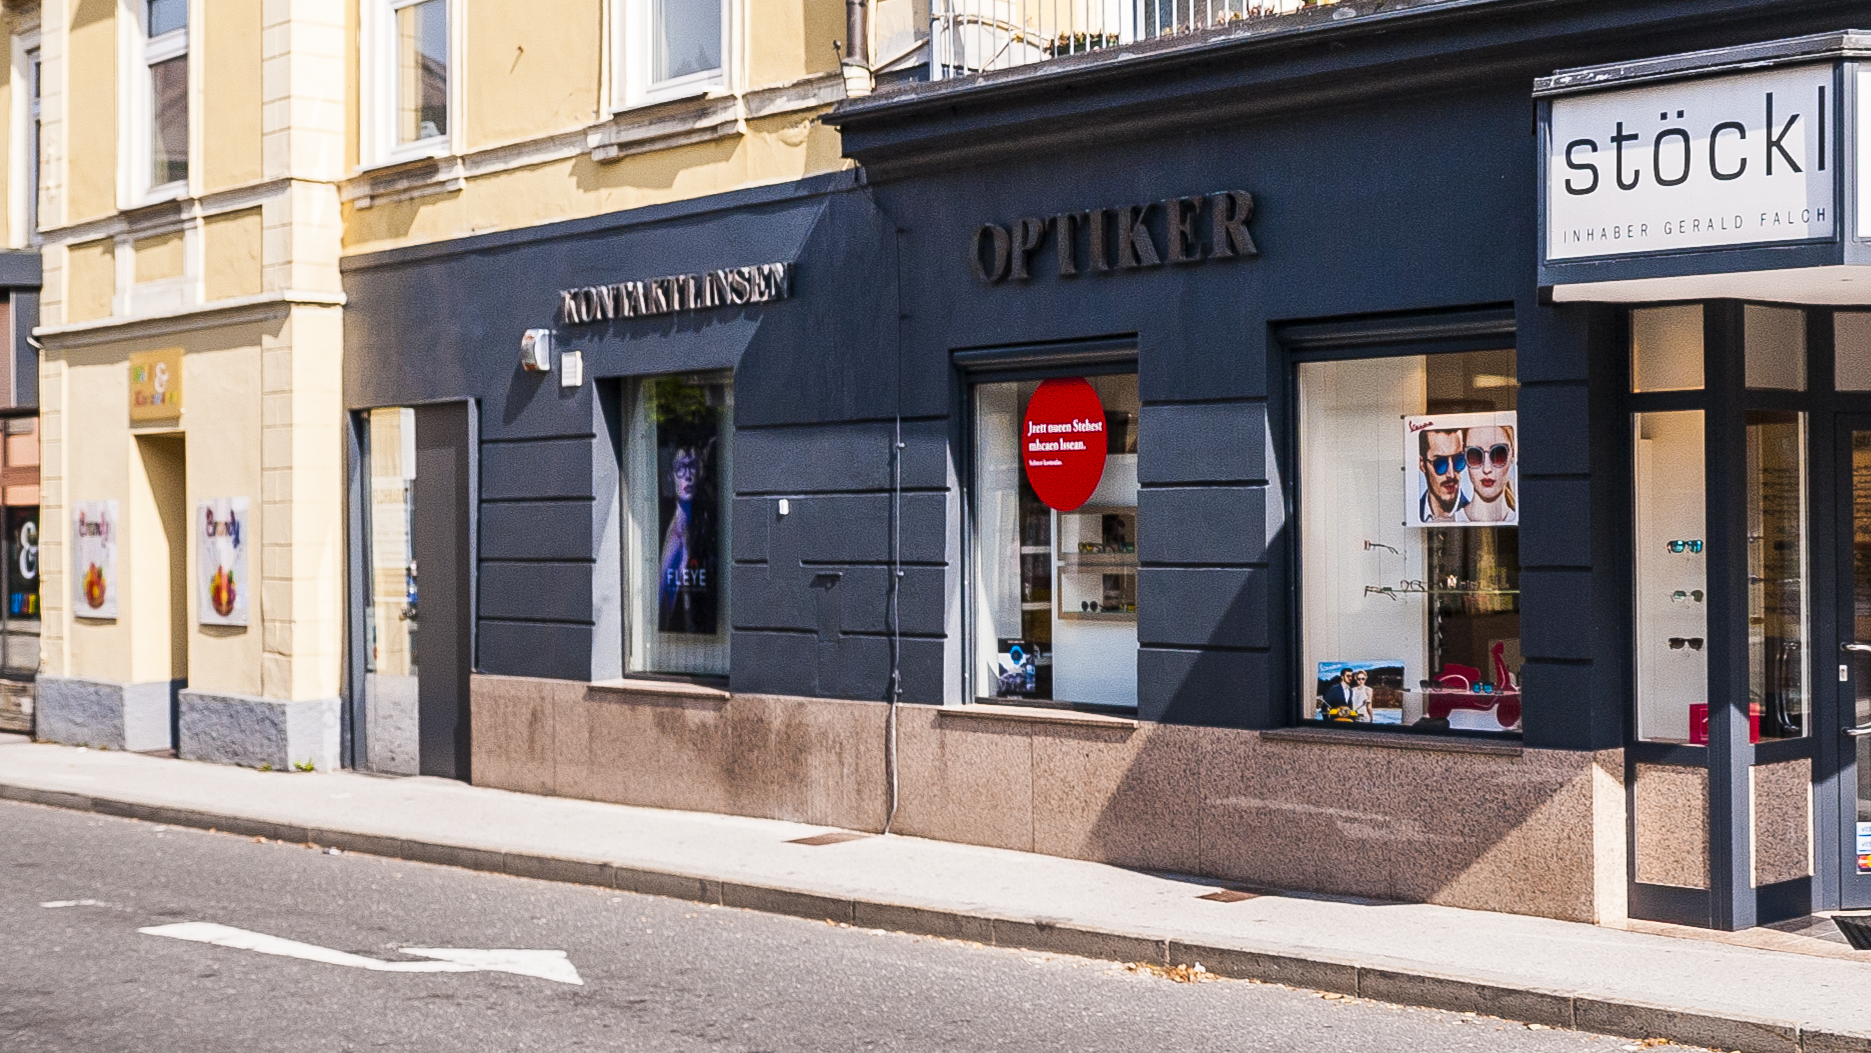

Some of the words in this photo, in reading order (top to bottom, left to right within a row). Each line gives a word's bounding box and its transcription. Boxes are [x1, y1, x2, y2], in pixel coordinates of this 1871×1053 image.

[1564, 85, 1826, 196] stöckl
[967, 189, 1258, 283] OPTIKER
[1563, 223, 1648, 244] INHABER
[1663, 214, 1744, 236] GERALD
[1759, 207, 1826, 227] FALCH
[559, 261, 796, 325] KONTAKTLINSEN
[666, 568, 706, 586] FLEYE
